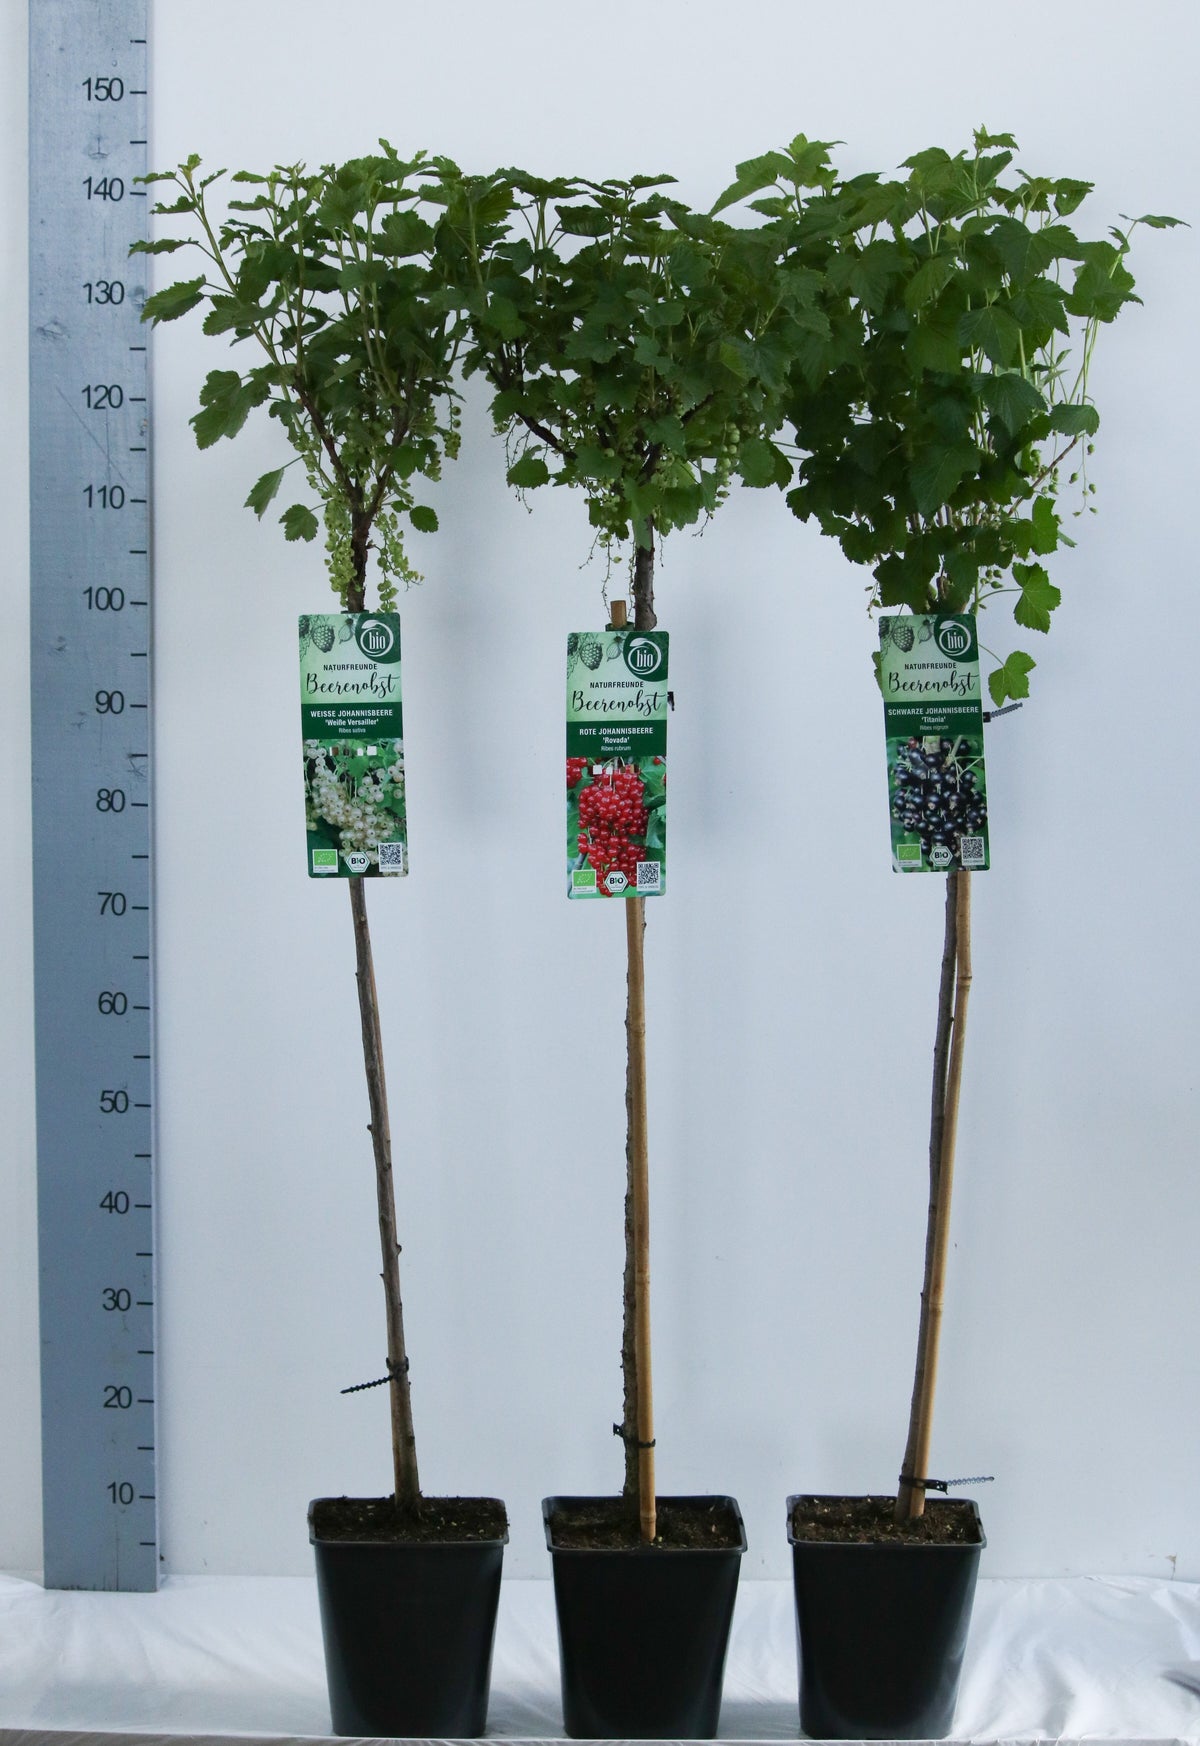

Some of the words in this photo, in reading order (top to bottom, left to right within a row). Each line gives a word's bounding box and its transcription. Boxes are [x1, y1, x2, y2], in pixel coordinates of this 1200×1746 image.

[82, 77, 124, 102] 150
[82, 176, 124, 202] 140
[82, 280, 125, 305] 130
[81, 385, 123, 410] 120
[83, 485, 125, 509] 110
[83, 586, 125, 611] 100
[369, 631, 386, 650] bio
[946, 631, 964, 649] bio
[323, 663, 378, 671] NATURFREUNDE
[636, 649, 653, 668] bio
[904, 662, 957, 670] NATURFREUNDE
[306, 672, 400, 699] Beerenobst
[590, 681, 644, 689] NATURFREUNDE
[888, 670, 979, 697] Beerenobst
[95, 690, 125, 714] 90
[310, 710, 336, 718] WEISSE
[338, 709, 393, 717] JOHANNISBEERE
[572, 689, 666, 717] Beerenobst
[888, 707, 924, 716] SCHWARZE
[925, 706, 979, 715] JOHANNISBEERE
[579, 728, 597, 736] ROTE
[598, 727, 654, 735] JOHANNISBEERE
[96, 788, 126, 813] 80
[97, 892, 127, 916] 70
[98, 991, 128, 1015] 60
[99, 1090, 129, 1113] 50
[99, 1191, 130, 1214] 40
[102, 1288, 131, 1312] 30
[103, 1385, 132, 1409] 20
[107, 1481, 134, 1505] 10
